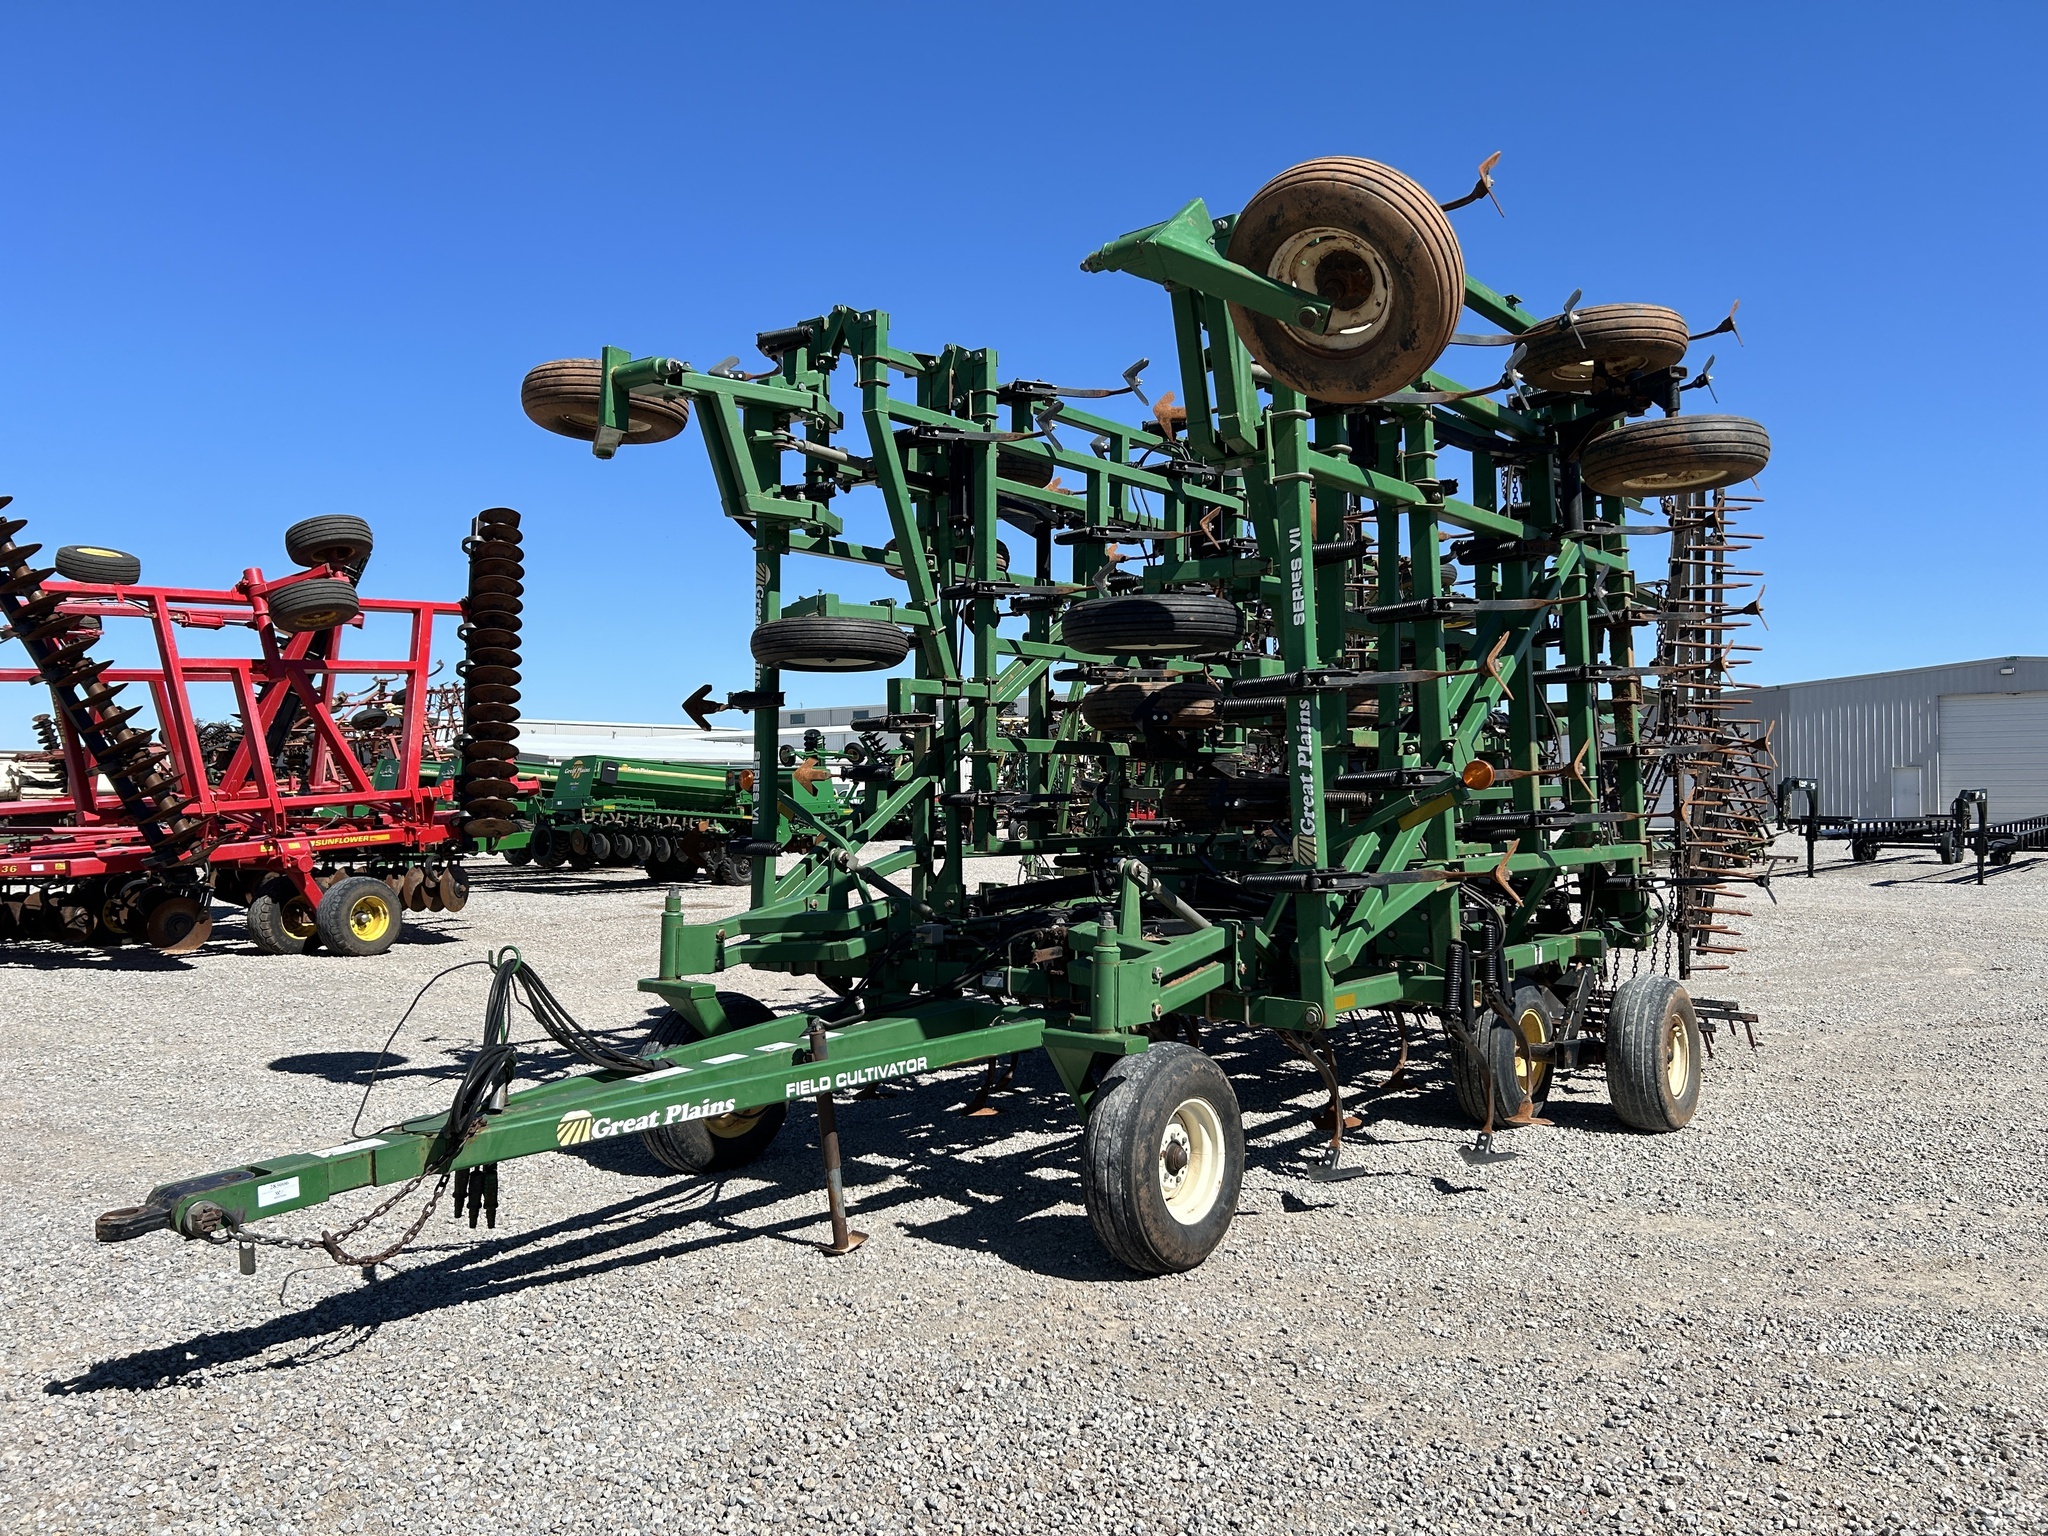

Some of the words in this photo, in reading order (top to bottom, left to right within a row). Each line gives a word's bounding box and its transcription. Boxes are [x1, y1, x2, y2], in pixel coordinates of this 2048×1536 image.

[1289, 527, 1301, 552] VII
[756, 585, 764, 628] Grea
[1291, 557, 1305, 626] SERIES
[1296, 699, 1312, 771] Plains
[752, 807, 760, 825] VII
[1300, 773, 1316, 836] Great
[314, 835, 370, 847] SUNFLOWER
[785, 1076, 831, 1098] FIELD
[836, 1056, 928, 1087] CULTIVATOR
[592, 1109, 661, 1139] Great
[662, 1098, 736, 1126] Plains
